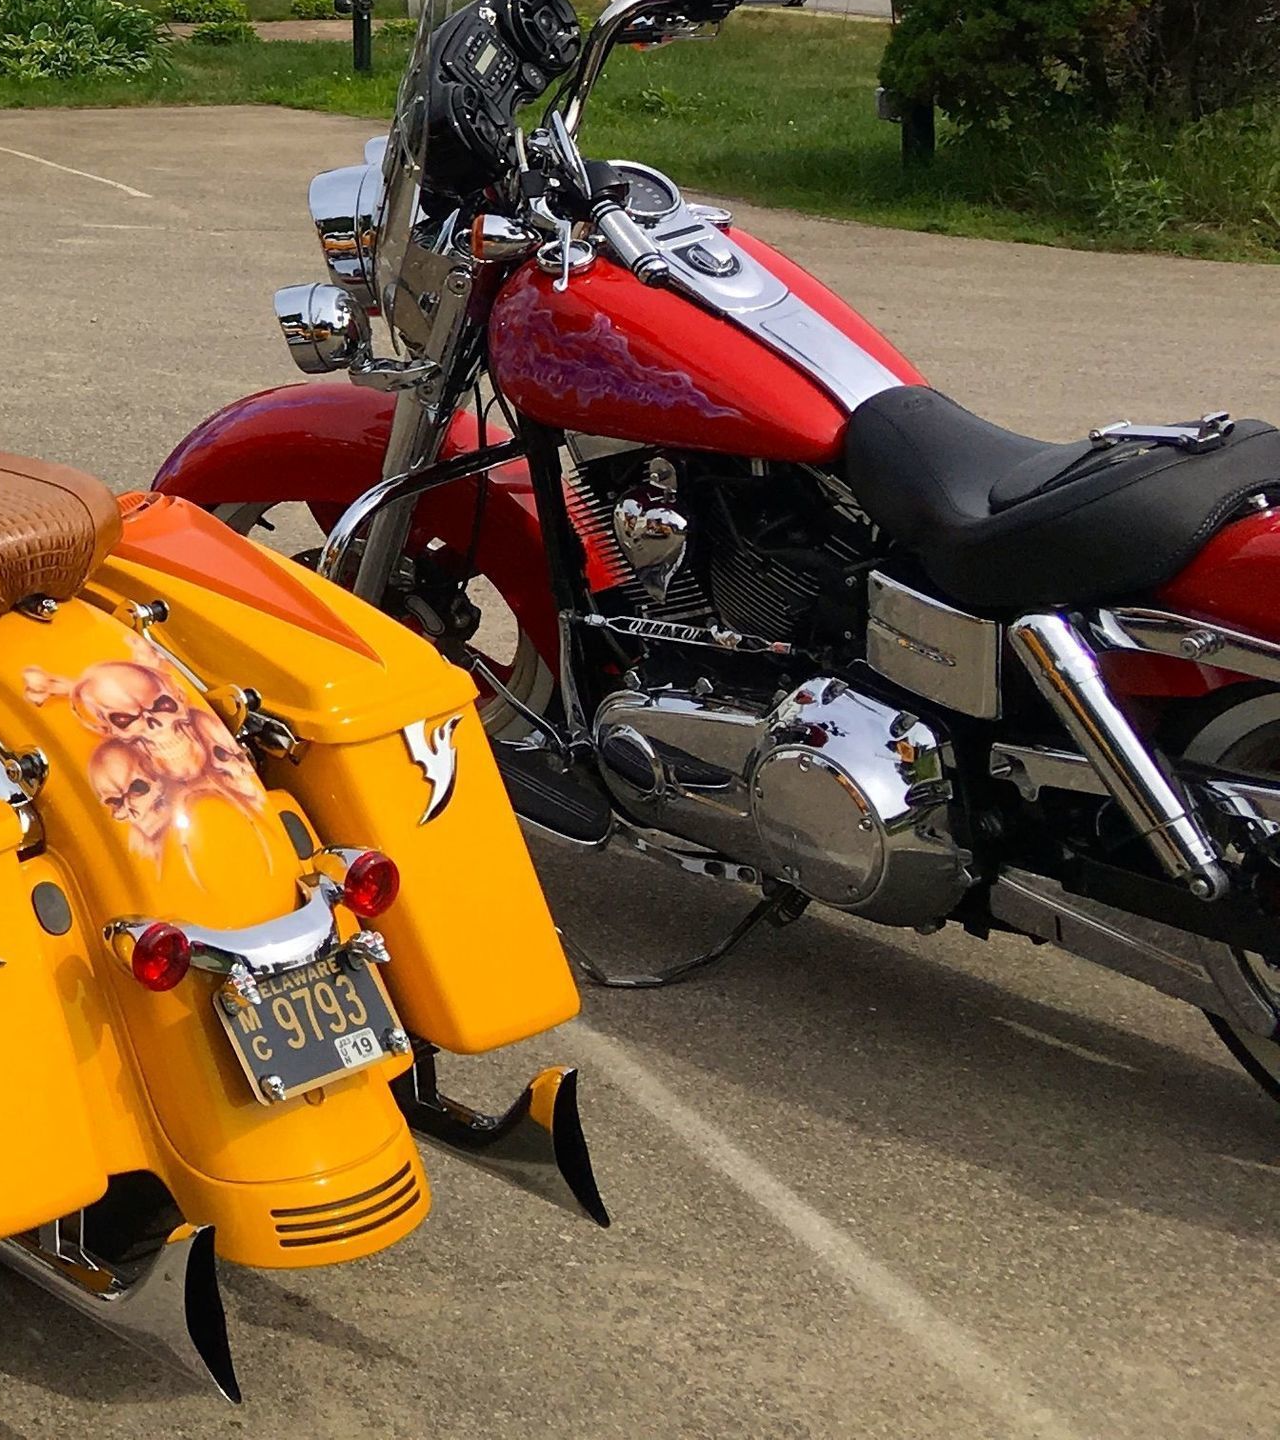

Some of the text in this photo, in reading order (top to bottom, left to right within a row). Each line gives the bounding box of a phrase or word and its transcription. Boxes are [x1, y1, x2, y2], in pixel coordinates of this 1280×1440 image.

[258, 957, 341, 999] ELAWARE
[272, 974, 368, 1049] 9793
[351, 1036, 374, 1058] 19
